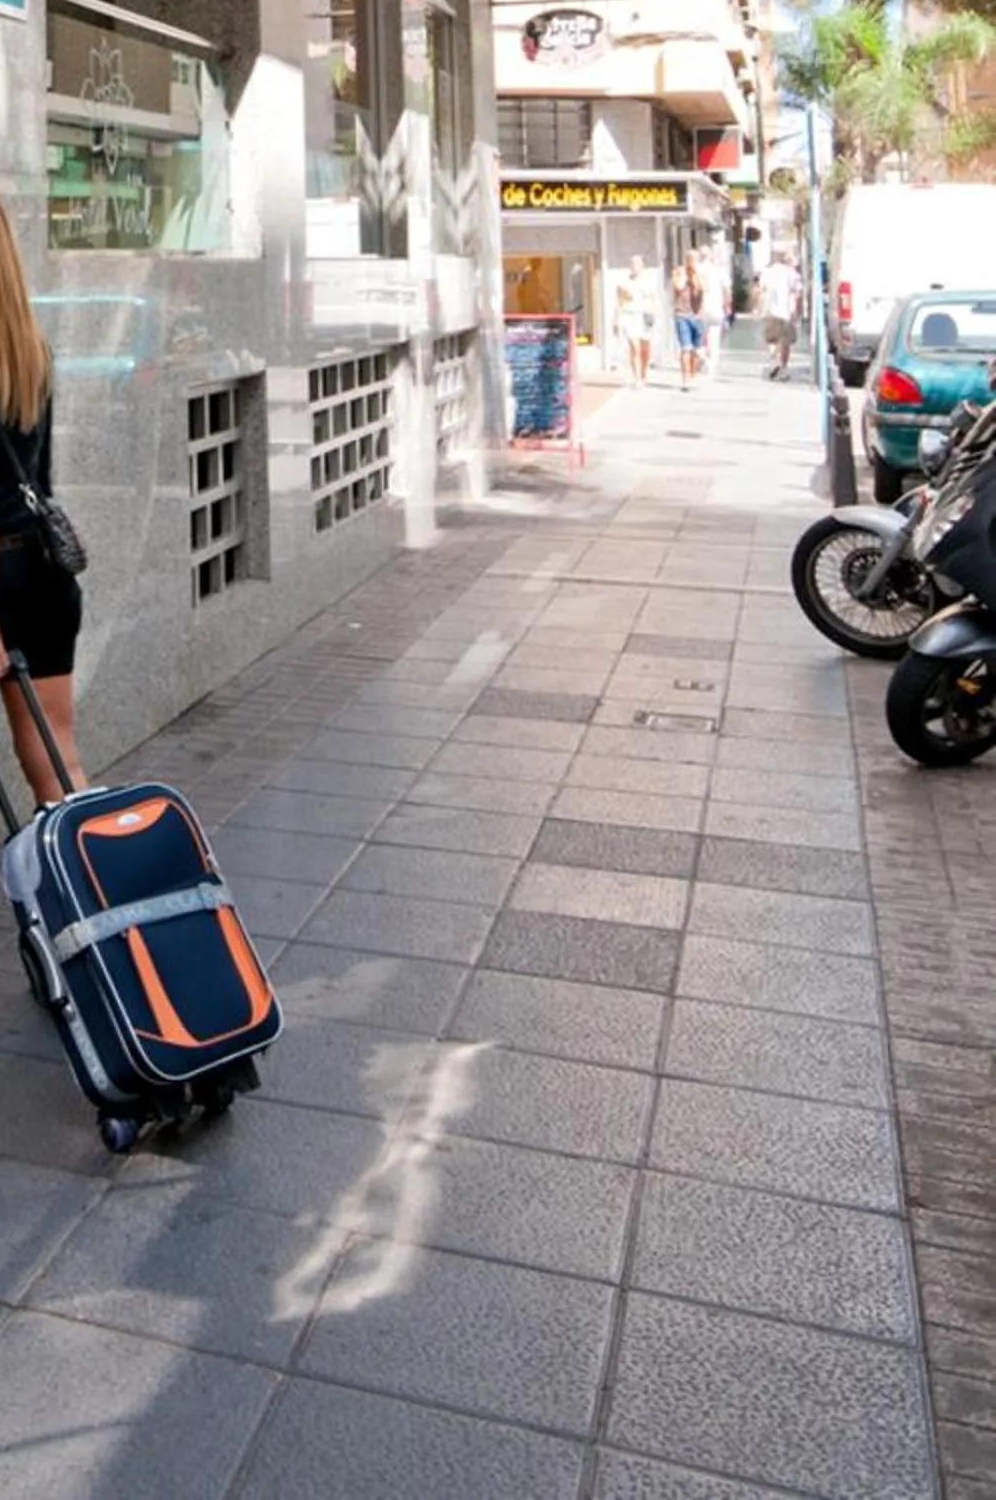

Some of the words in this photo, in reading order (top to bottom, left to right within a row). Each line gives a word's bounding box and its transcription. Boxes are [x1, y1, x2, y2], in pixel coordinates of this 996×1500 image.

[503, 183, 526, 207] de
[529, 183, 591, 206] Coches
[593, 187, 604, 211] y
